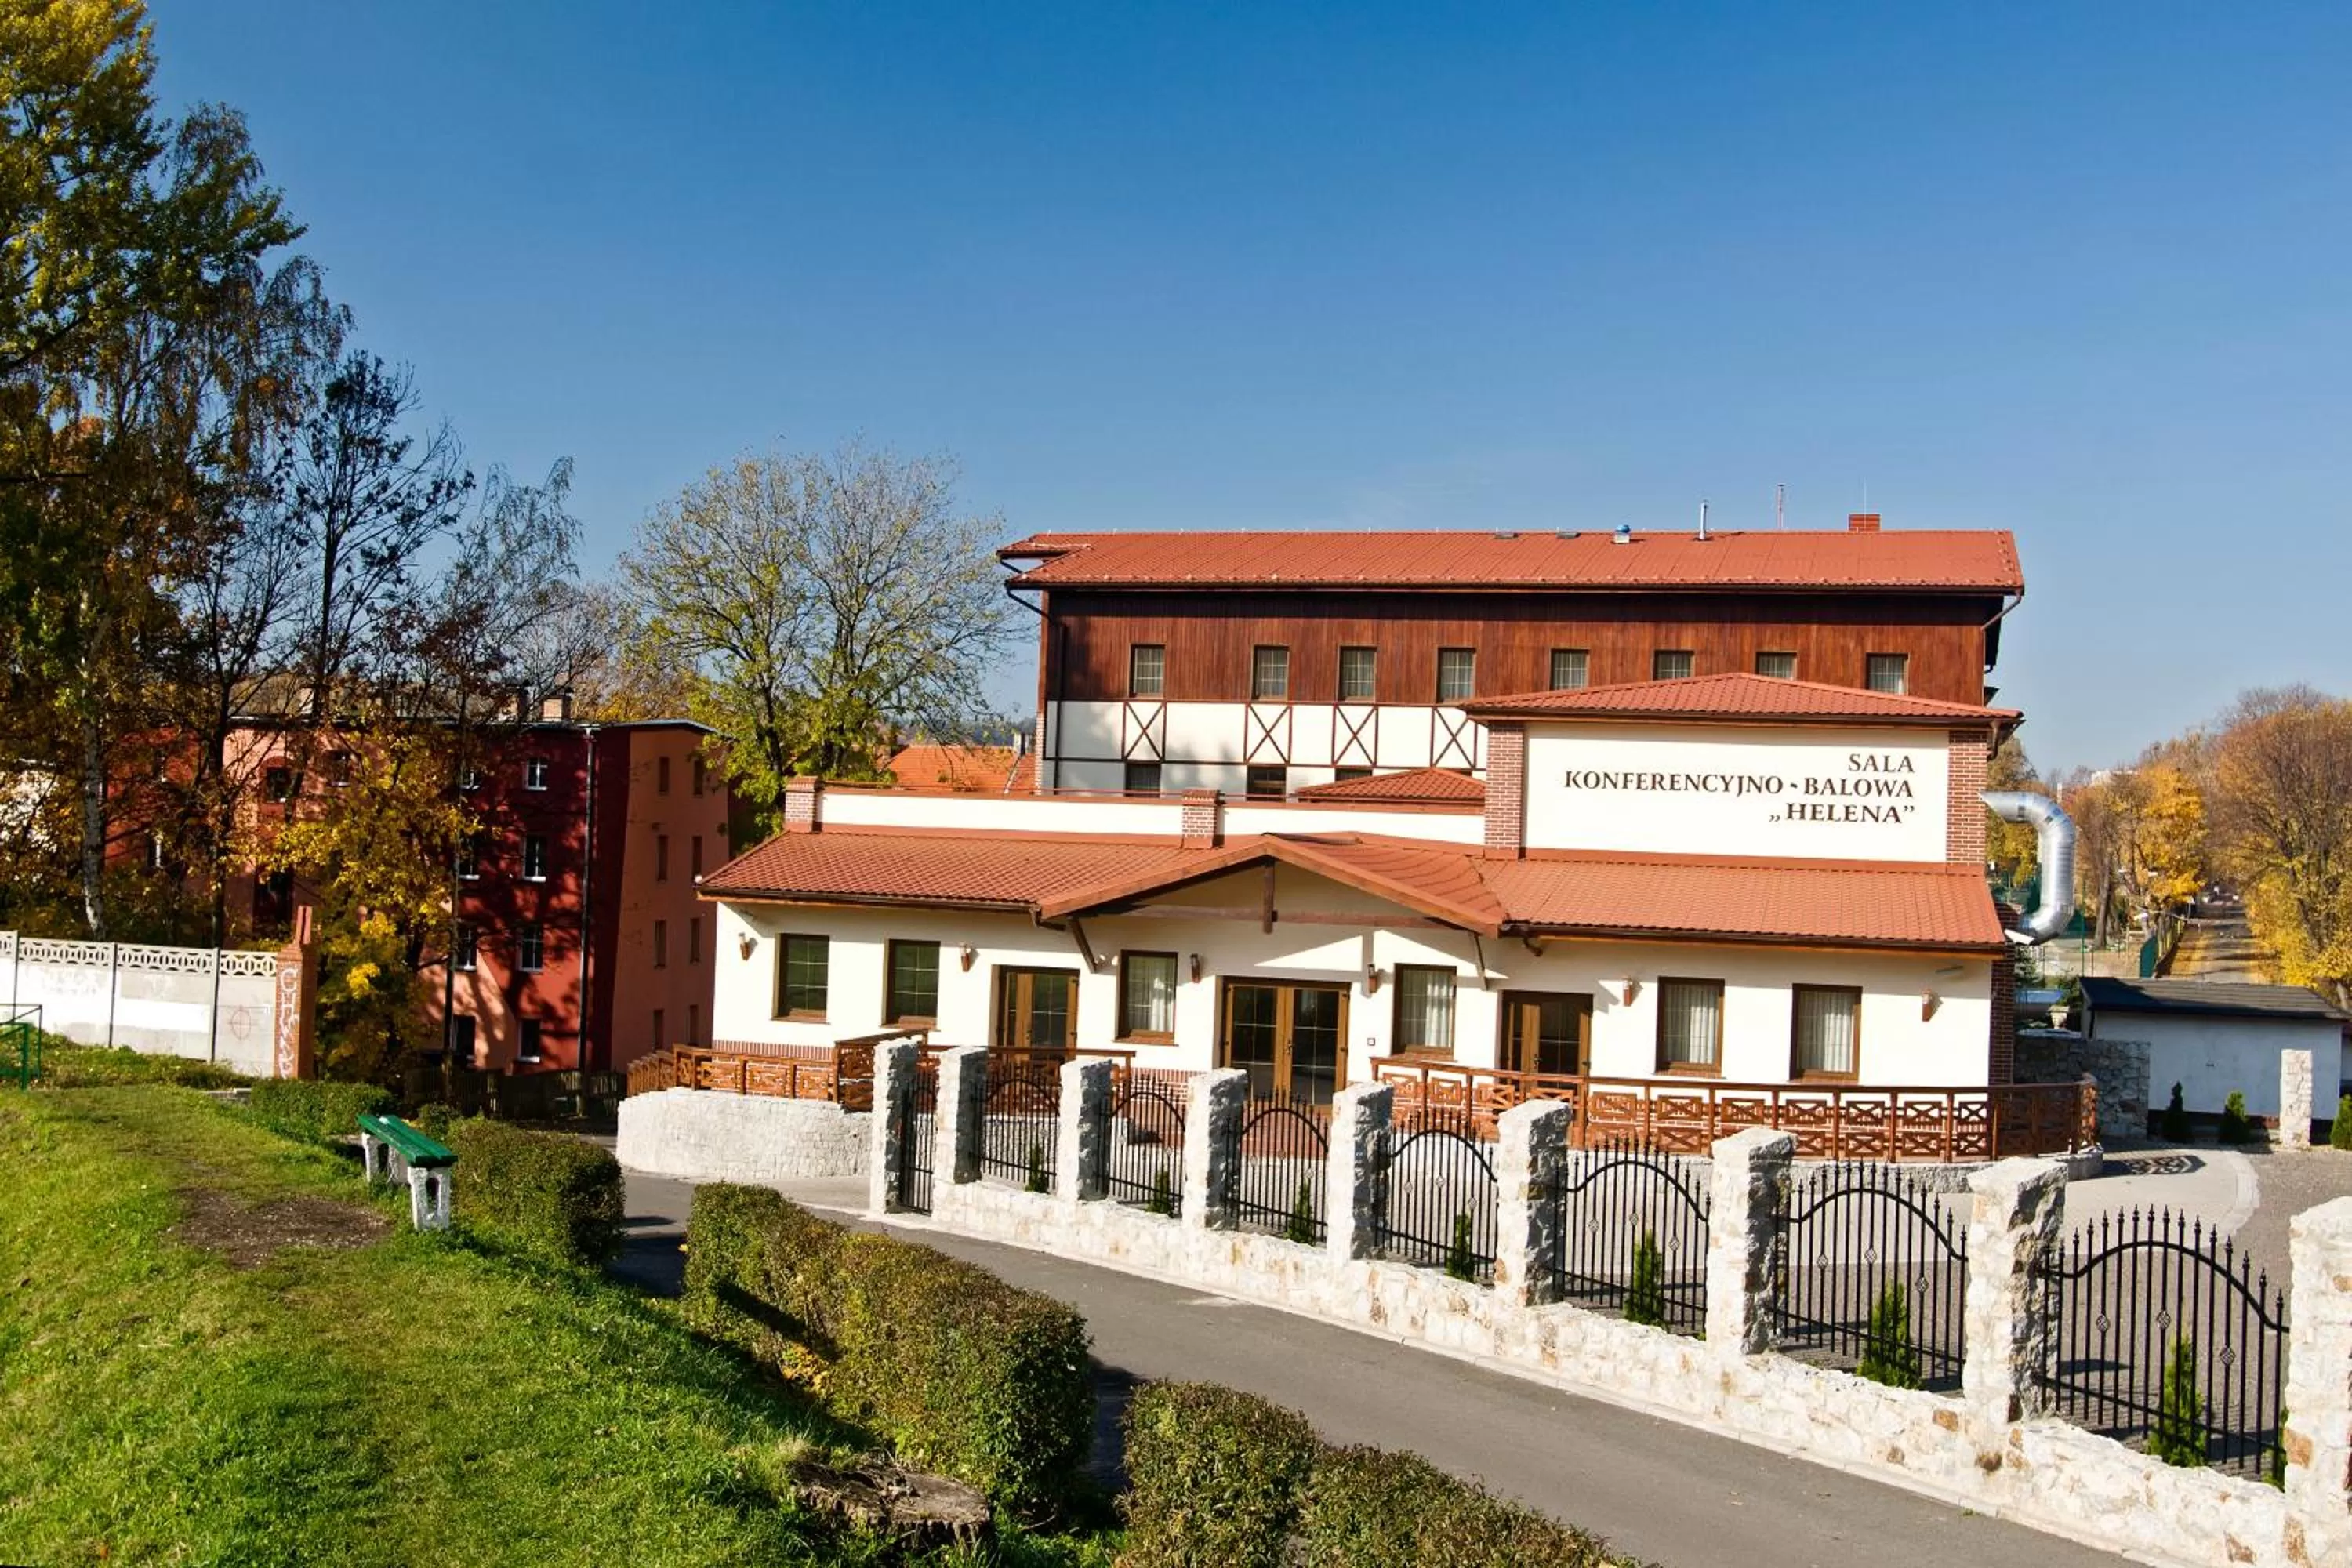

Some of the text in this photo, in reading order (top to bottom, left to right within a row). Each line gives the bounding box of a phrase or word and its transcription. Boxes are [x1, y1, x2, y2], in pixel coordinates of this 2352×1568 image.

[1848, 753, 1915, 772] SALA
[1564, 771, 1784, 797] KONFERENCYJNO
[1804, 777, 1913, 797] BALOWA
